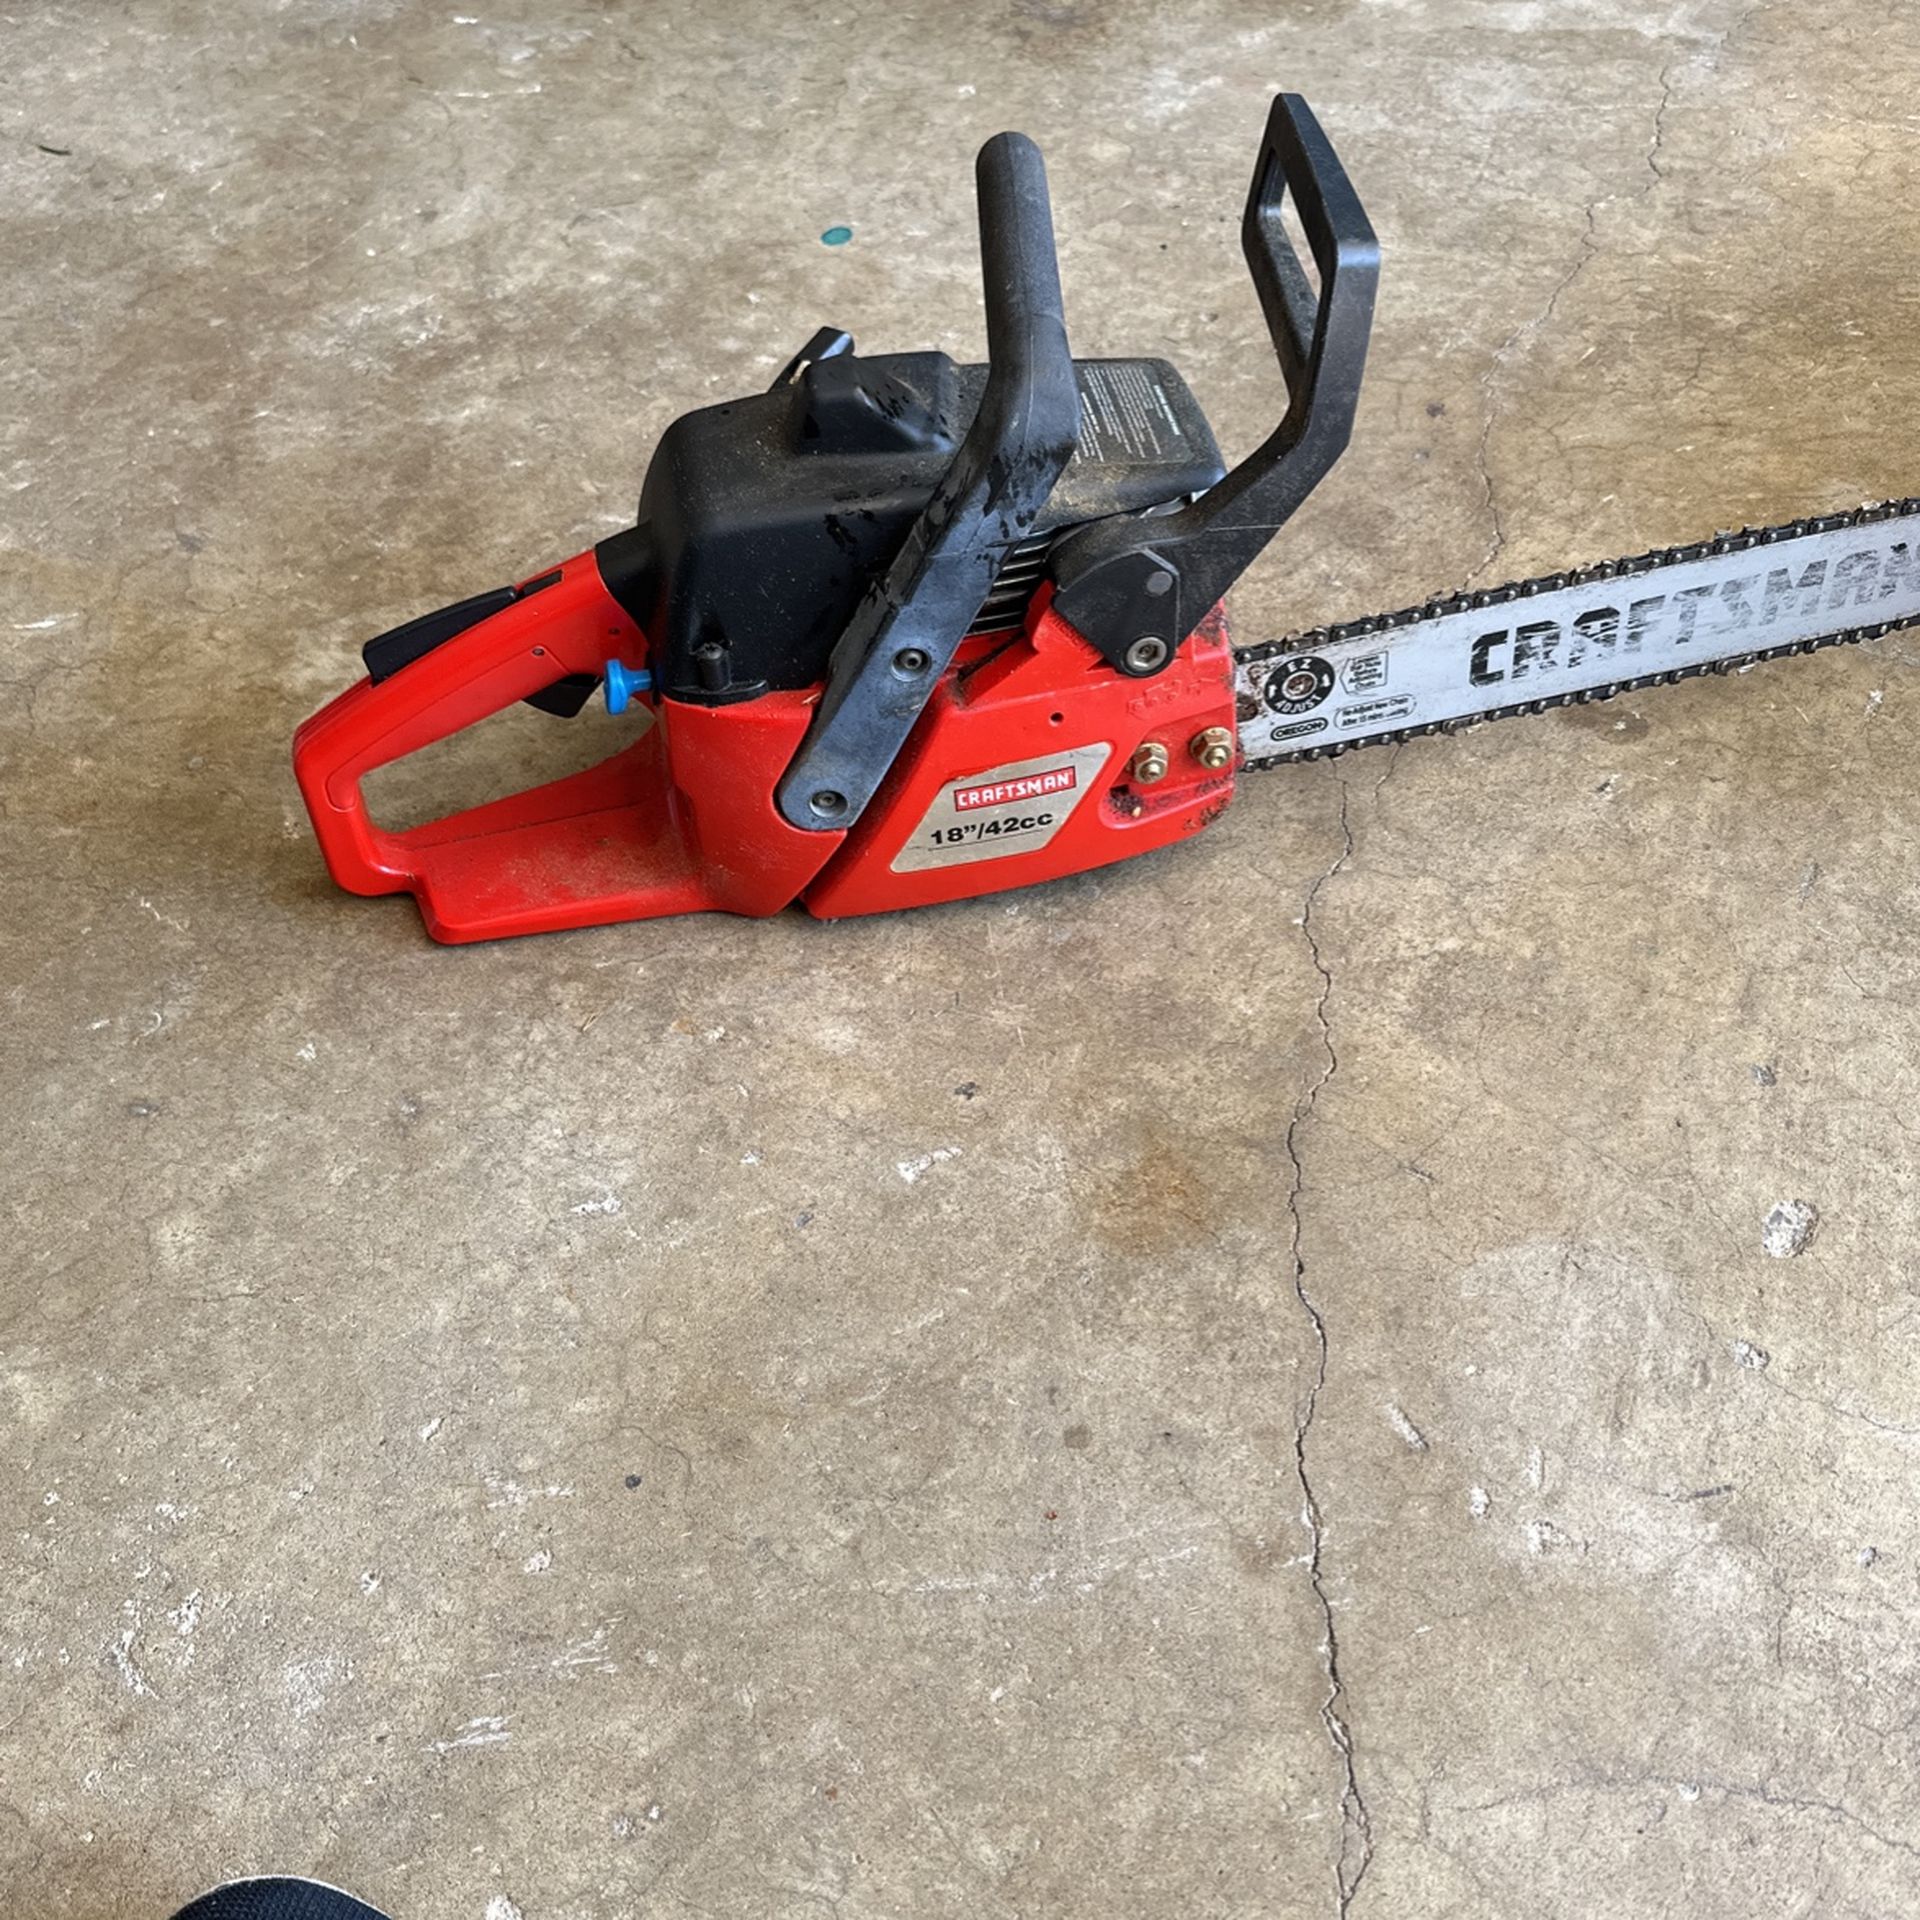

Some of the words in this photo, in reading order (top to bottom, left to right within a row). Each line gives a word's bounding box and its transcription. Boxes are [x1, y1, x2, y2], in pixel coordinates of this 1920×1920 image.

[1275, 694, 1321, 713] ADJUST
[1275, 721, 1323, 738] OREGON
[957, 772, 1069, 807] CRAFTSMAN
